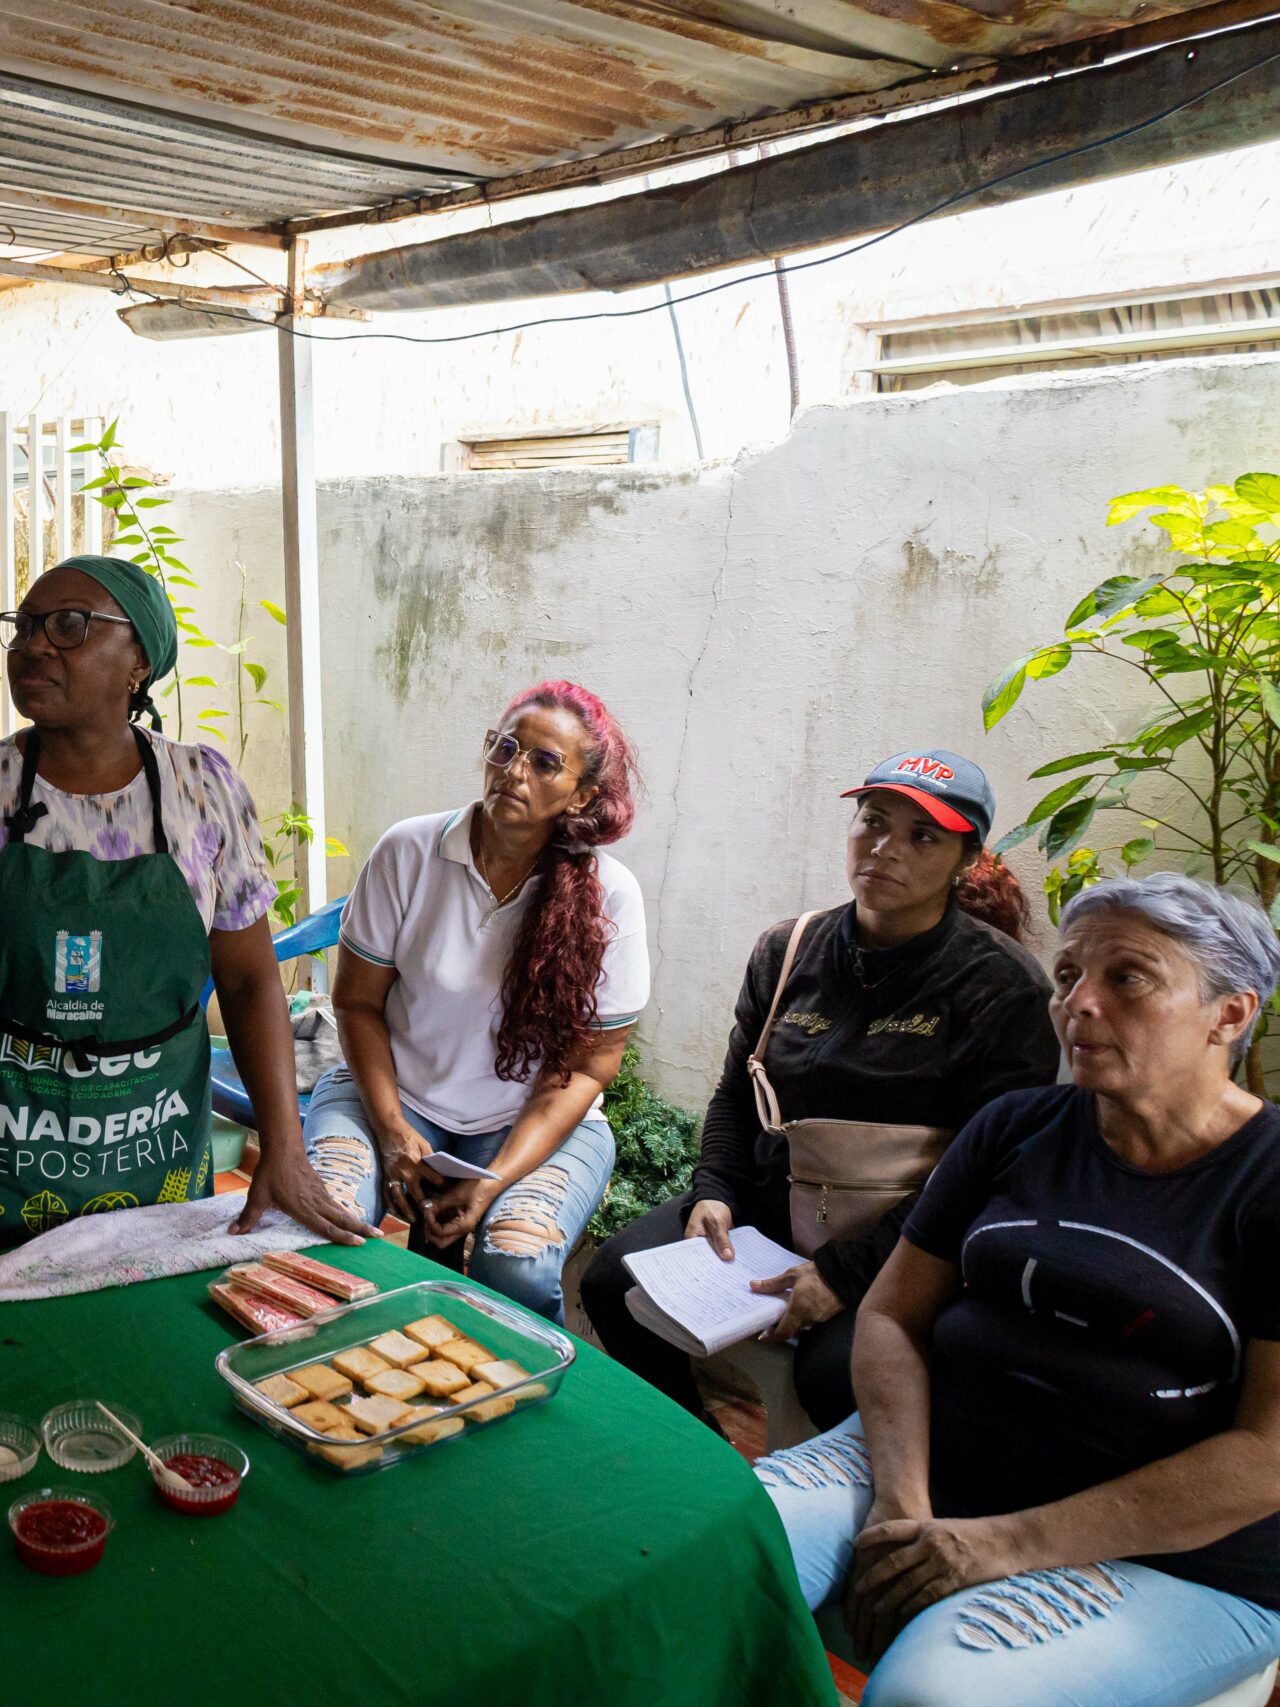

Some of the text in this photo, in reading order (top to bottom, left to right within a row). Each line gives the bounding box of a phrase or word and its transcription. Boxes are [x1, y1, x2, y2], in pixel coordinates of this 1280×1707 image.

[895, 757, 955, 782] MVP
[90, 1000, 105, 1011] de
[46, 1008, 103, 1021] Maracaibo
